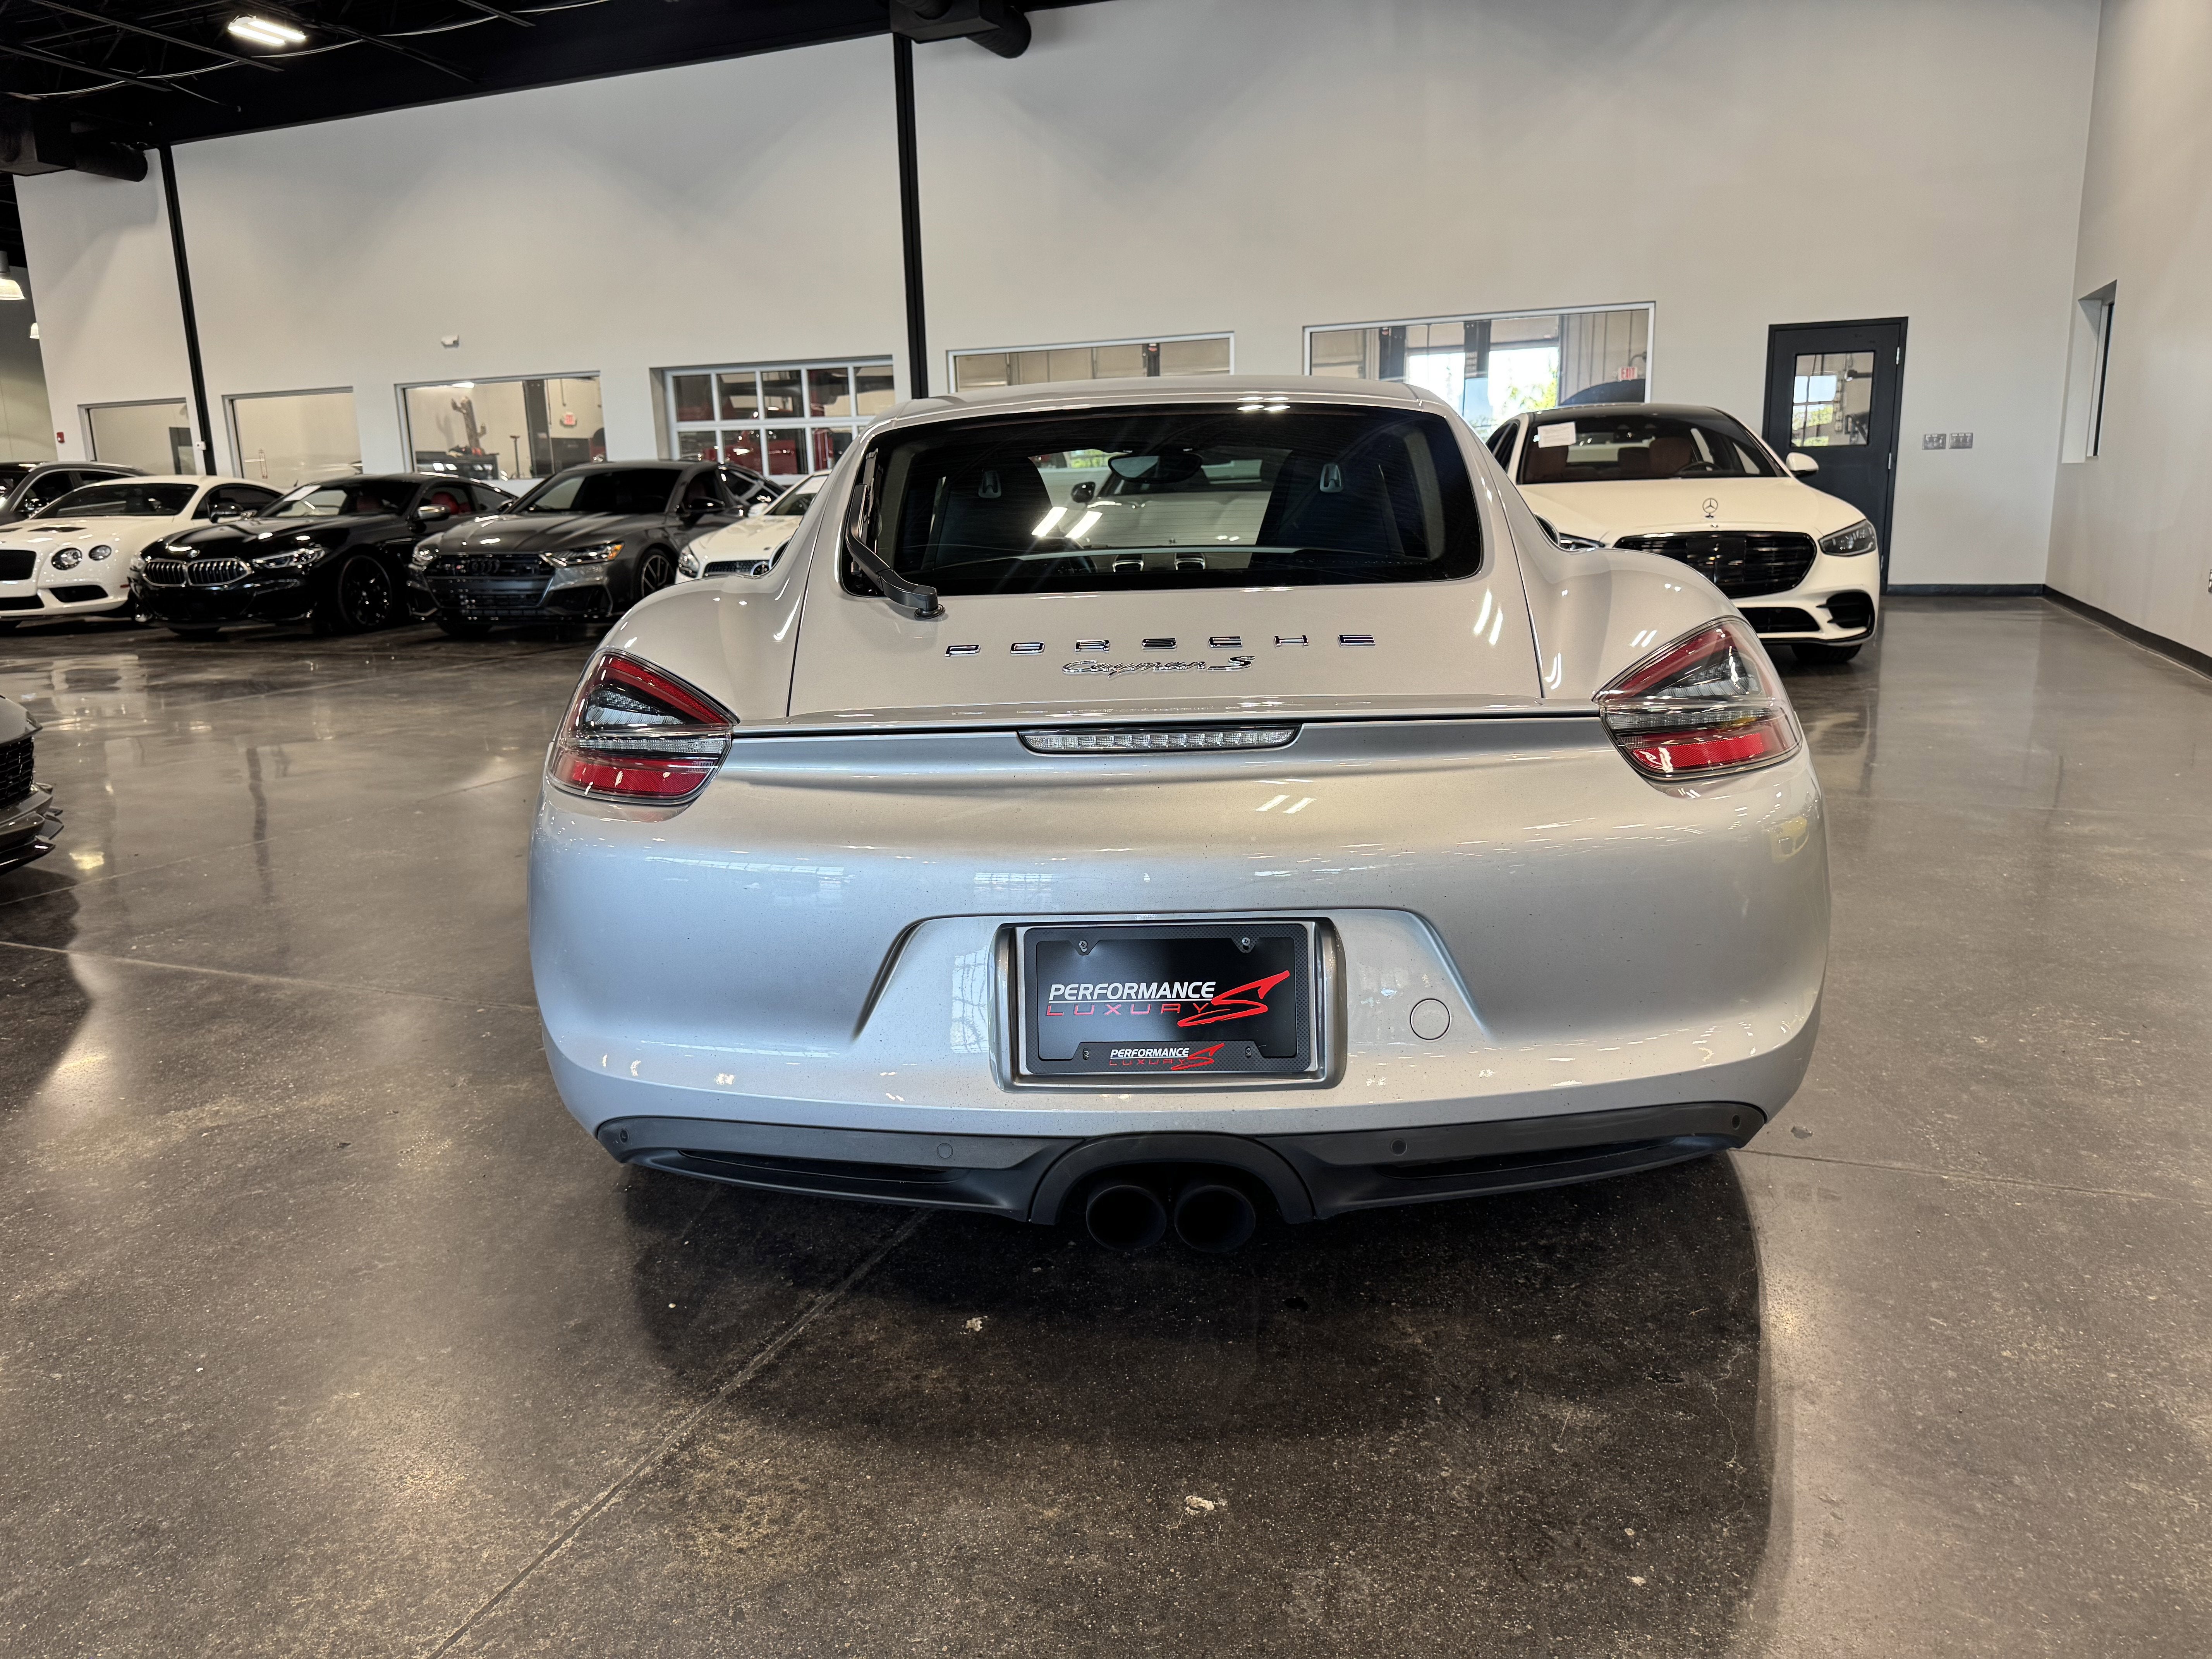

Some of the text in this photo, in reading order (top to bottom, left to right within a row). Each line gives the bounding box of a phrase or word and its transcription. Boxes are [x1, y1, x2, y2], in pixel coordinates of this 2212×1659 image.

[944, 634, 1376, 658] PORSCHE
[1063, 656, 1256, 678] Cayman S
[1049, 981, 1216, 1000] PERFORMANCE
[1046, 1003, 1209, 1016] LUXURY
[1110, 1048, 1190, 1058] PERFORMANCE
